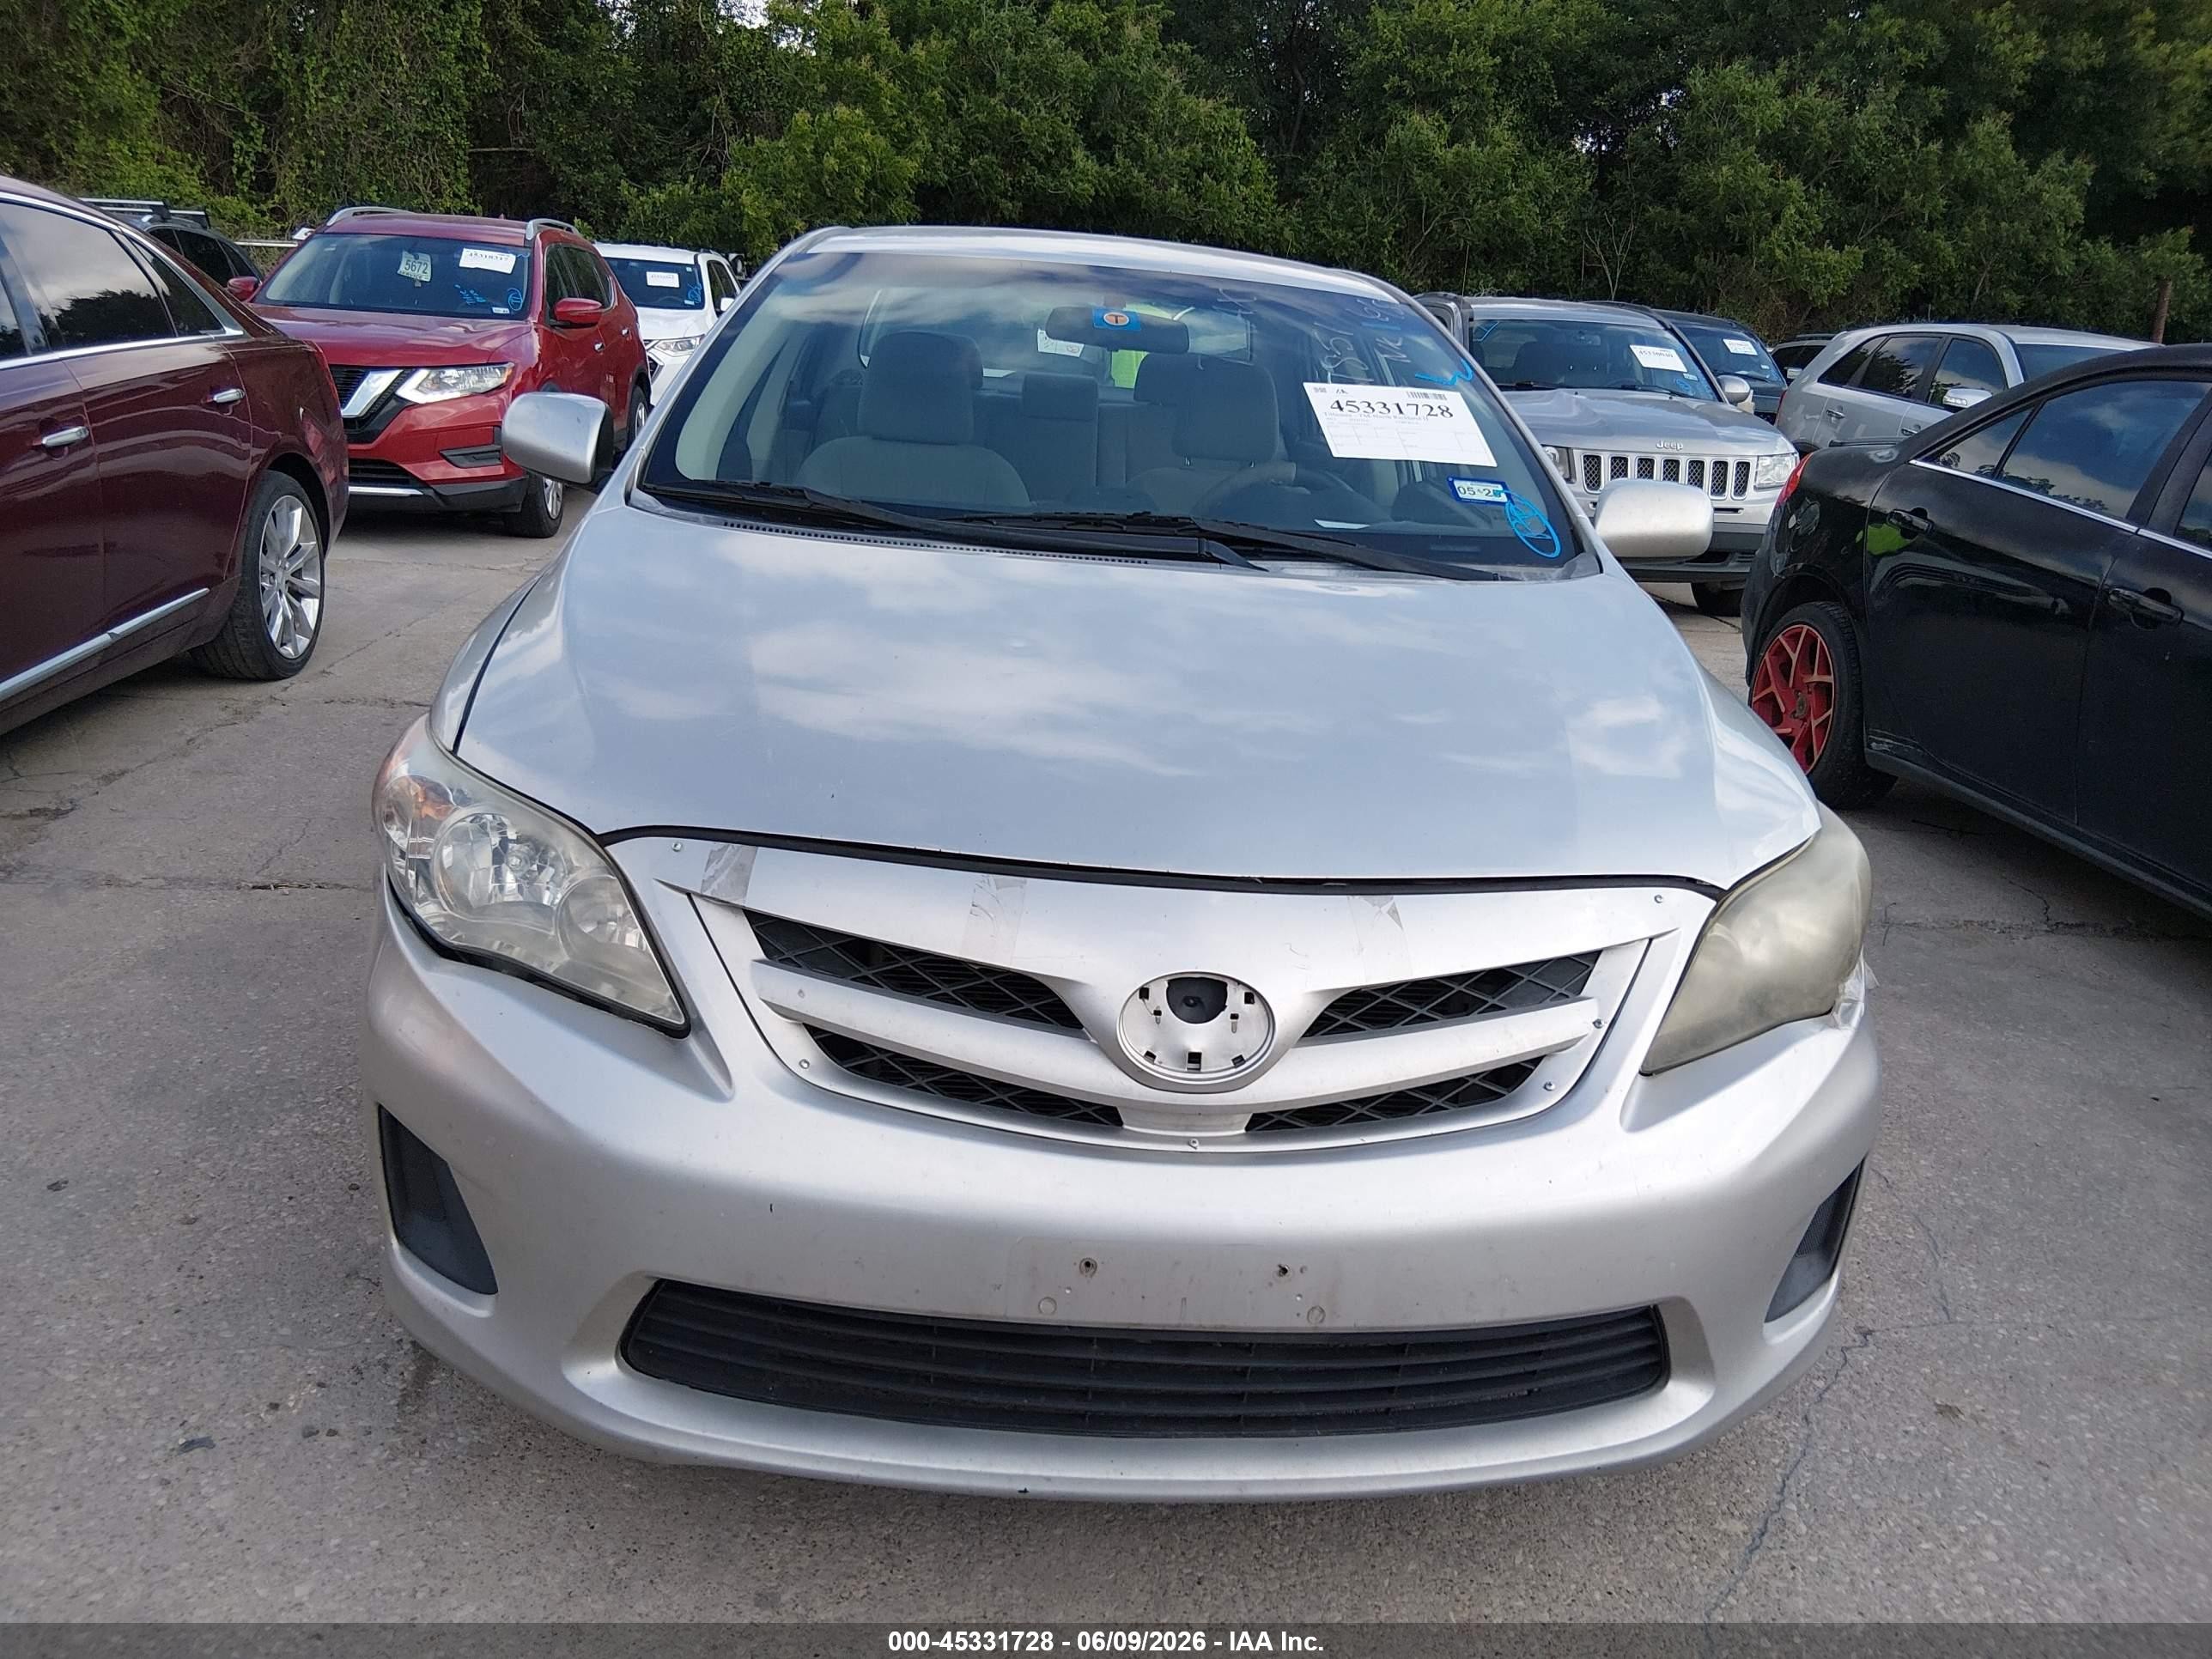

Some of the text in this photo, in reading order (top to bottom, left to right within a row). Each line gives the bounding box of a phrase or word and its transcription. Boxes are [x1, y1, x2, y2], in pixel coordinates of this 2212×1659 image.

[404, 259, 428, 274] 5672
[1330, 399, 1454, 418] 45331728
[1656, 440, 1683, 451] Jeep
[1457, 486, 1476, 495] 05
